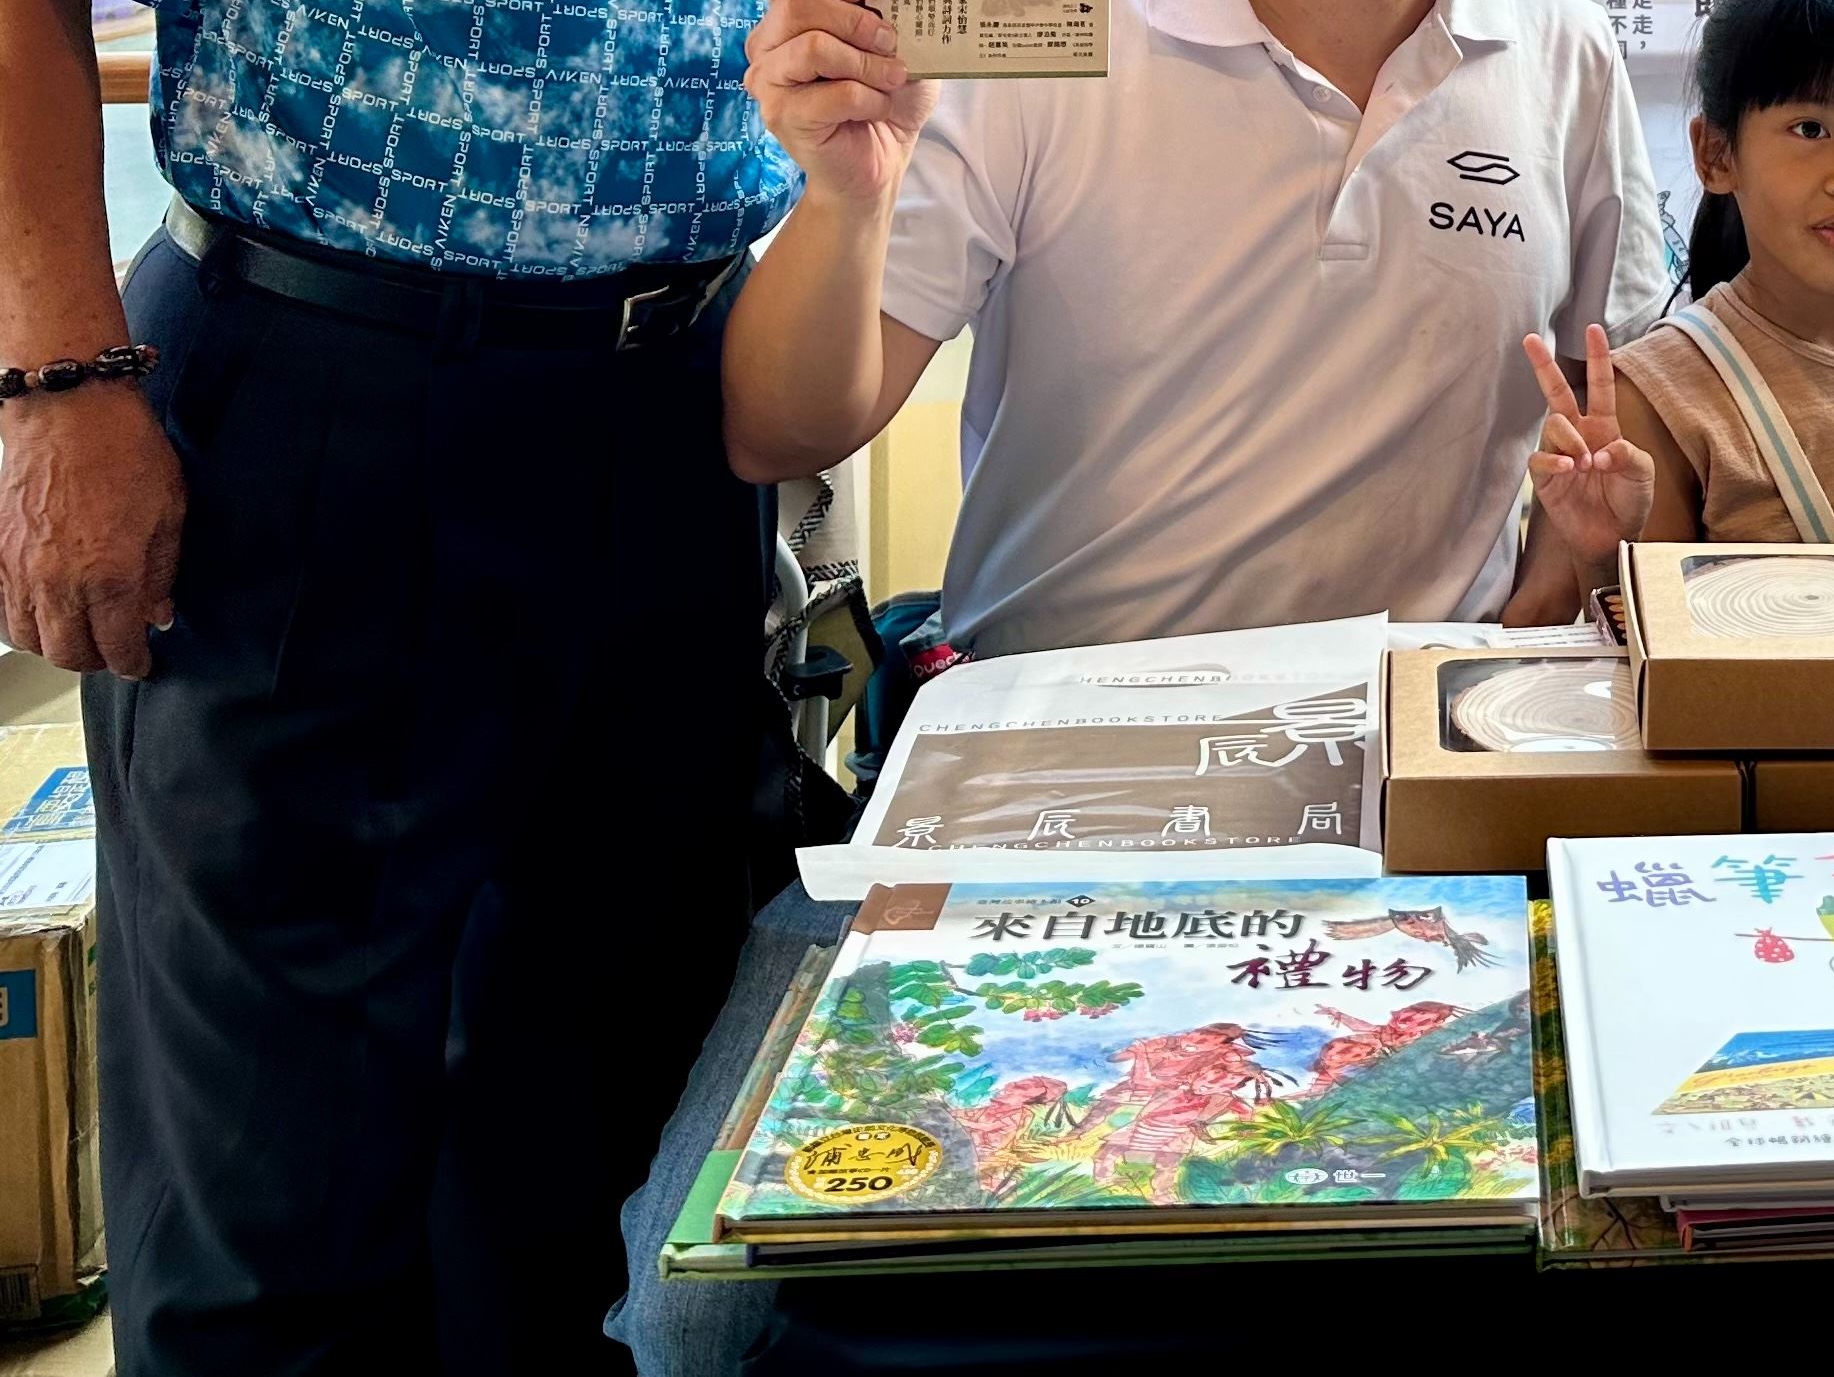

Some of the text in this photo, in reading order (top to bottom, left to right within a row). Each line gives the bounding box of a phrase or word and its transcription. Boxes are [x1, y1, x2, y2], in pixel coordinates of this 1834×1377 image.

[553, 3, 607, 18] SPORT
[477, 60, 535, 77] SPORT
[342, 90, 397, 109] SPORT
[472, 124, 527, 143] SPORT
[390, 169, 448, 192] SPORT
[525, 199, 583, 214] SPORT
[1428, 202, 1525, 242] SAYA
[375, 230, 434, 257] SPORT
[442, 253, 501, 270] SPORT
[968, 909, 1304, 941] 來自地底的
[1226, 939, 1432, 991] 禮物
[824, 1176, 893, 1193] 250
